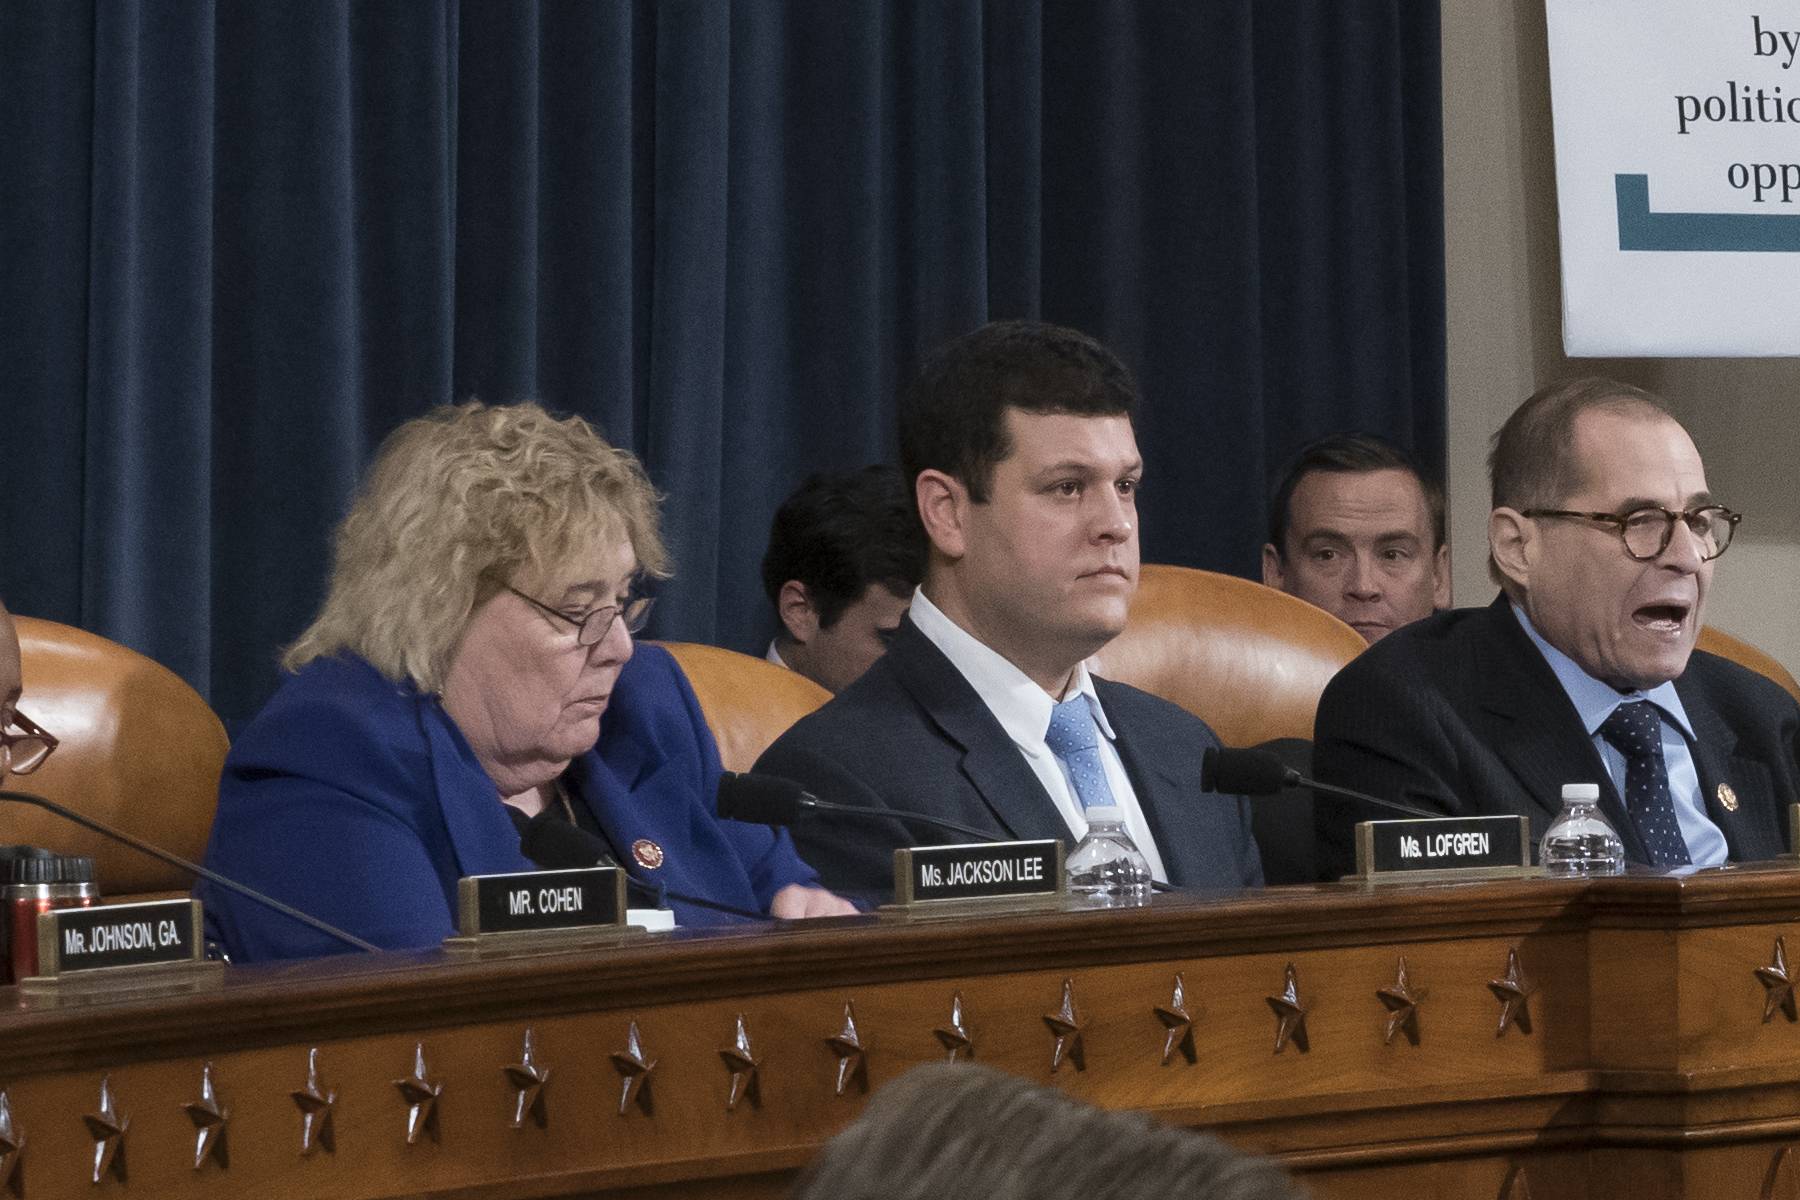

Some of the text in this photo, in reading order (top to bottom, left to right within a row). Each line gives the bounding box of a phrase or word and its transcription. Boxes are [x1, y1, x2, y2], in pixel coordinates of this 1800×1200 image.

[1426, 832, 1490, 857] LOFGREN
[946, 859, 1013, 886] JACKSON
[1016, 856, 1044, 881] LEE
[509, 886, 583, 915] MR. COHEN
[89, 922, 156, 952] JOHNSON,
[158, 920, 182, 946] GA.
